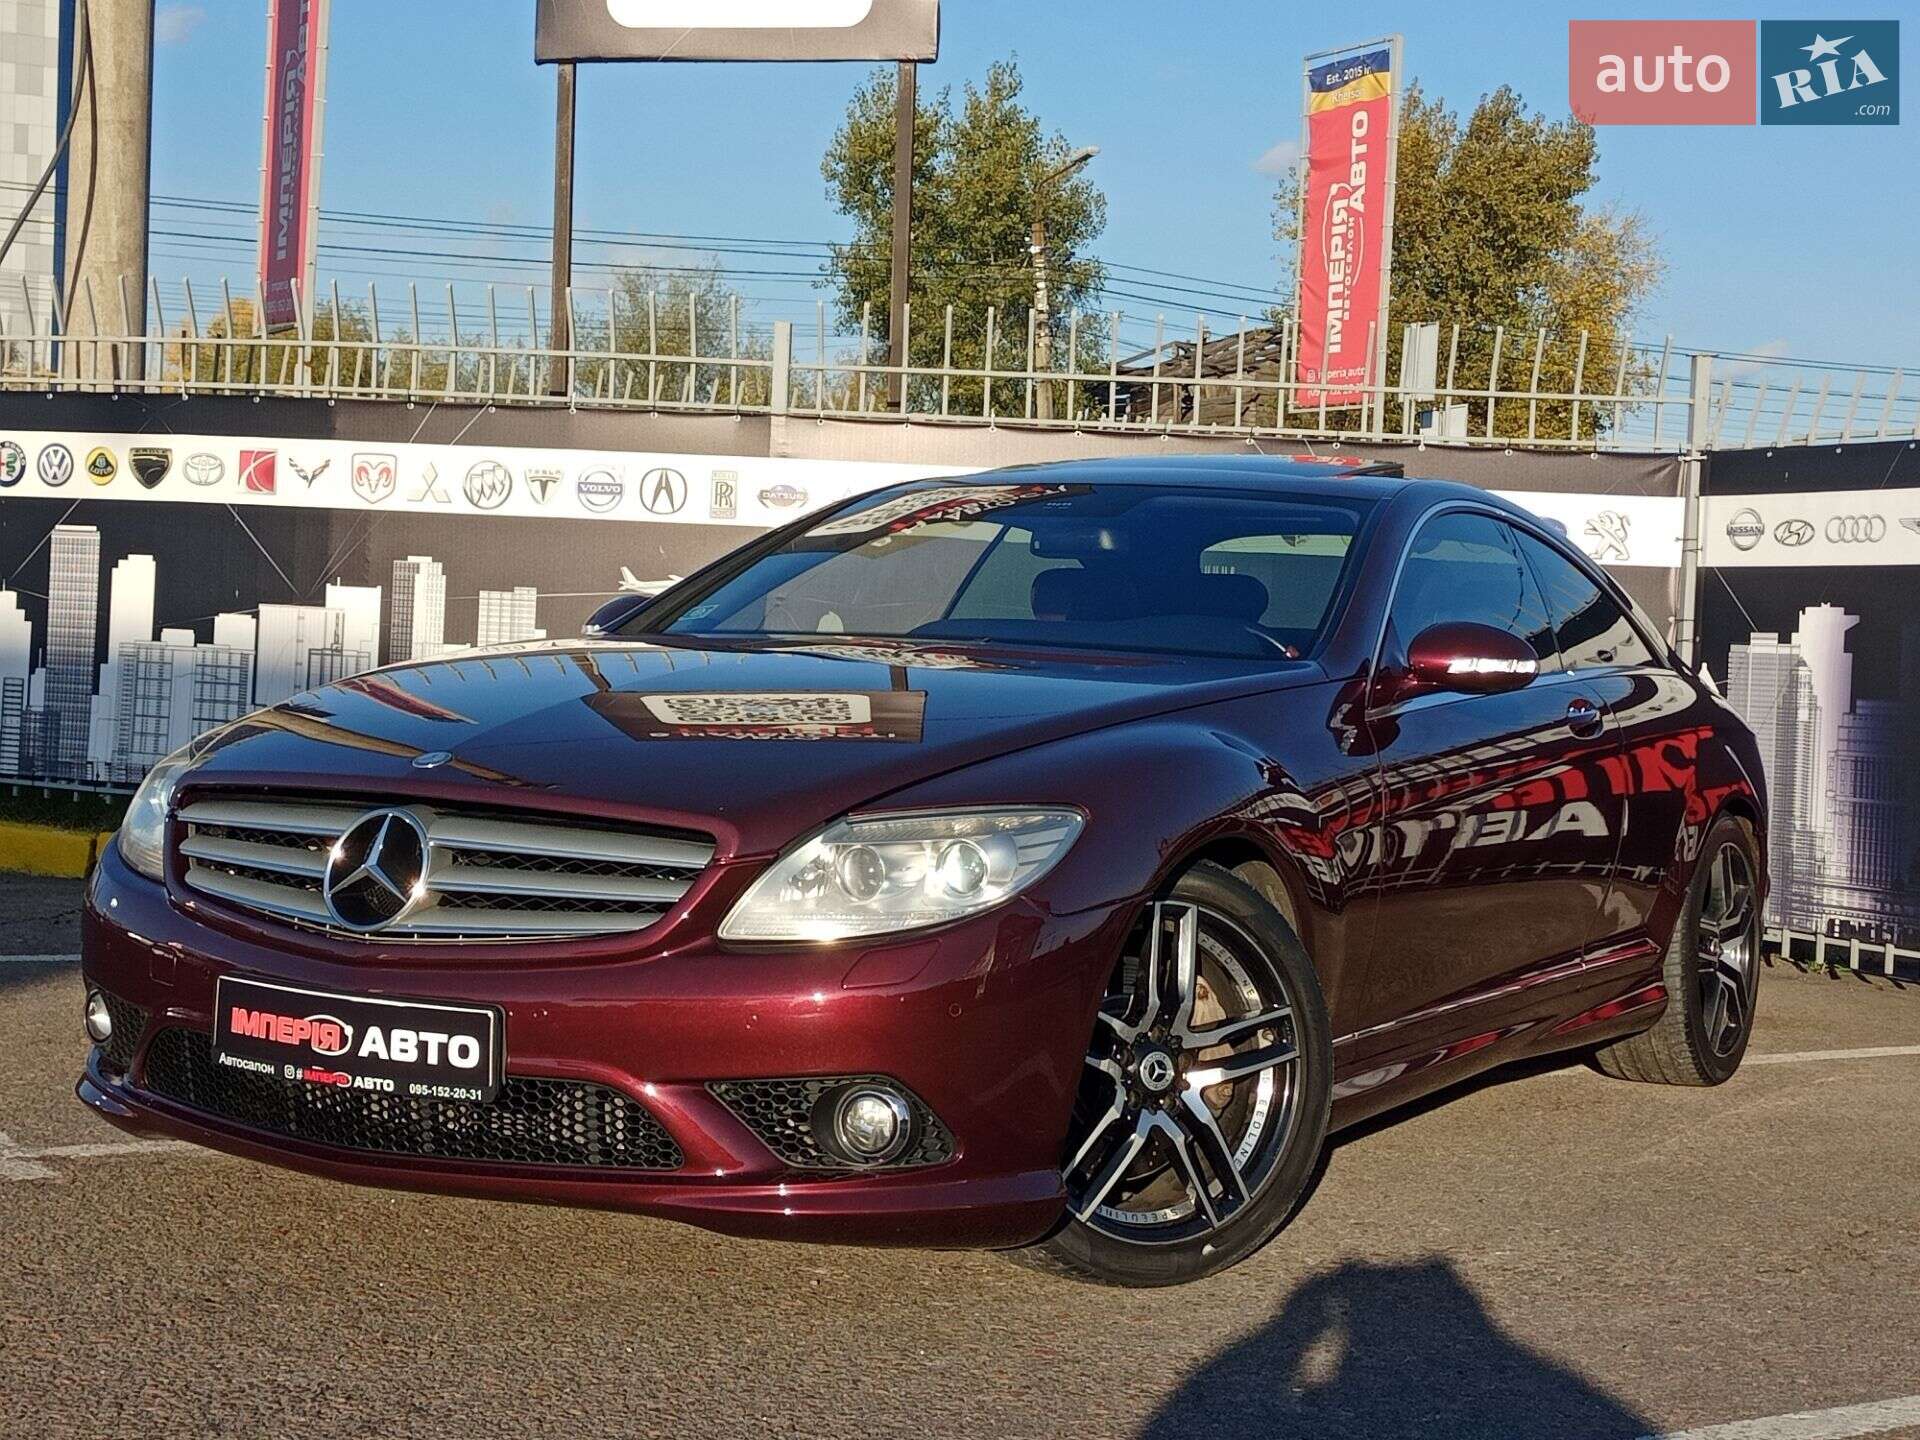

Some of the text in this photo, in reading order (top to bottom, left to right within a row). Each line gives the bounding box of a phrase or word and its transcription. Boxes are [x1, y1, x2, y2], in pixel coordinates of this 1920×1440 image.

[1326, 72, 1342, 85] Est.
[1343, 65, 1362, 80] 2015
[1350, 111, 1368, 212] АВТО
[579, 483, 621, 493] VOLVO
[1729, 525, 1762, 534] NISSAN
[358, 1026, 479, 1068] АВТО
[219, 1052, 275, 1075] Автосалон
[353, 1076, 395, 1092] АВТО
[409, 1083, 483, 1100] 095-152-20-31
